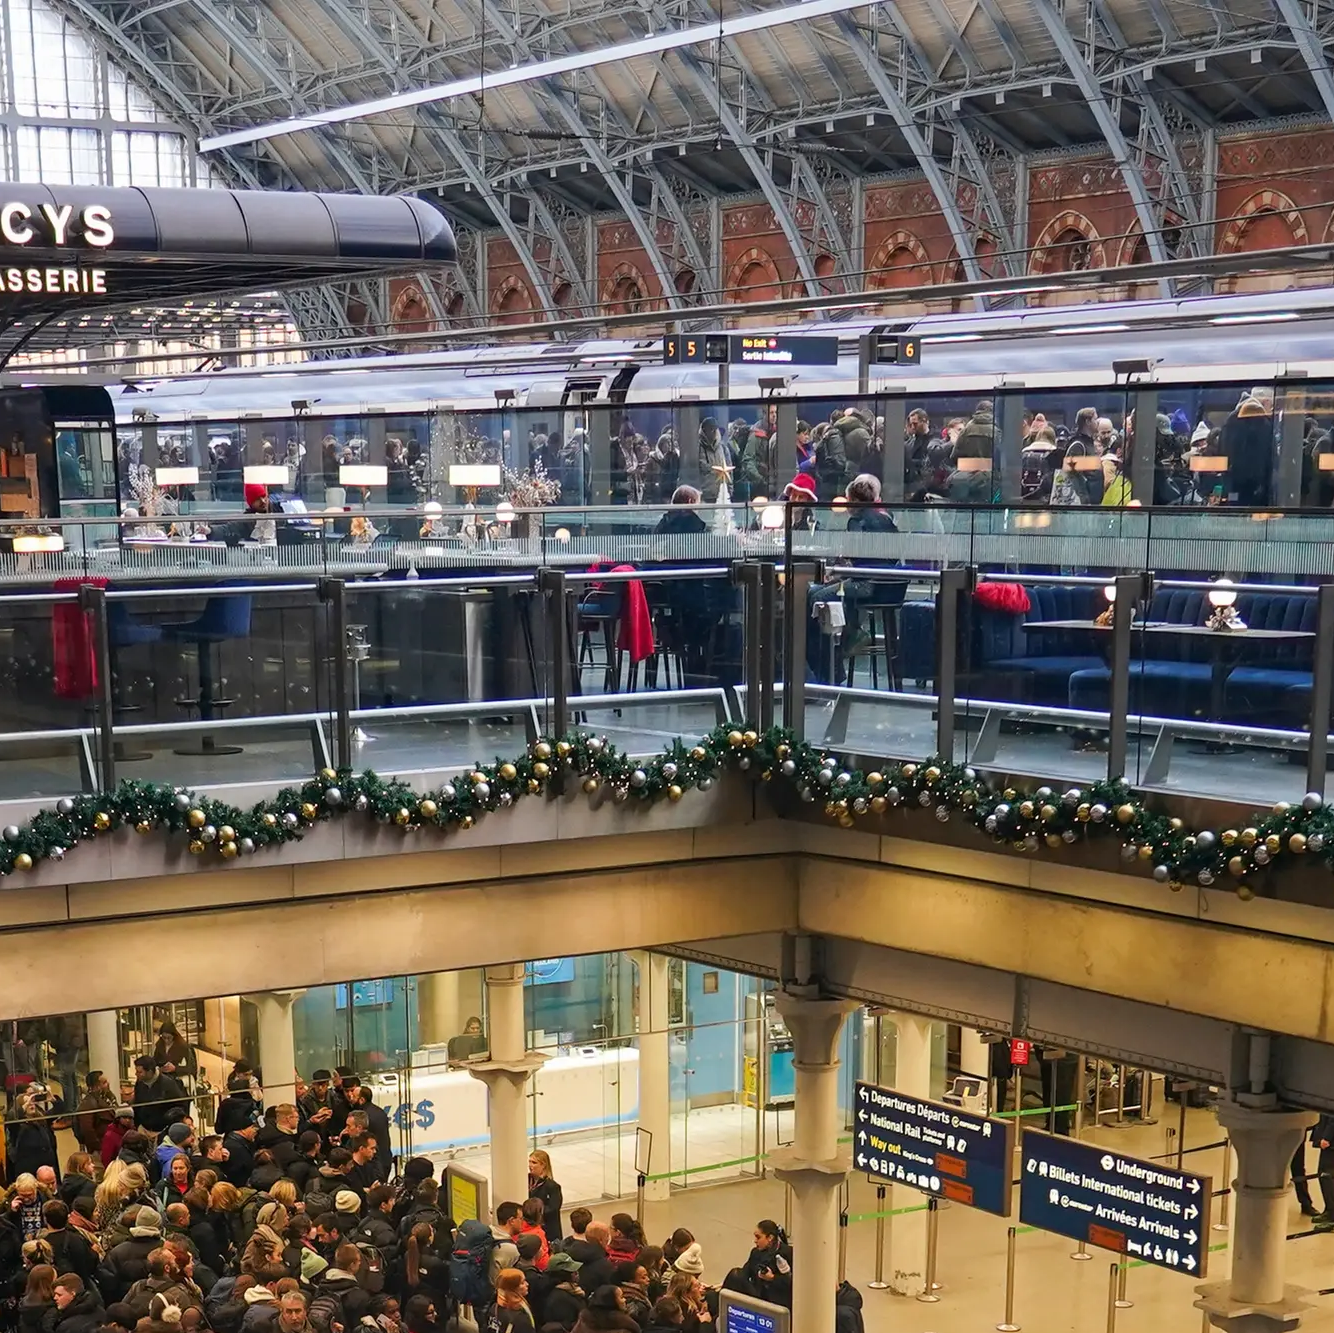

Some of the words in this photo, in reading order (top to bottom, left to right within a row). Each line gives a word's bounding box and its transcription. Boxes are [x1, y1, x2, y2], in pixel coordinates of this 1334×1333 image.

[668, 342, 675, 357] 5
[687, 341, 696, 357] 5
[742, 338, 753, 348] No
[754, 338, 767, 349] Exit
[905, 343, 914, 358] 6
[742, 350, 763, 361] Sortie
[871, 1090, 917, 1115] Departures
[917, 1104, 950, 1125] Départs
[870, 1113, 904, 1134] National
[905, 1123, 921, 1139] Rail
[870, 1134, 887, 1153] Way
[887, 1141, 902, 1156] out
[1116, 1159, 1183, 1190] Underground
[1049, 1164, 1080, 1186] Billets
[1081, 1174, 1145, 1204] International
[1146, 1193, 1181, 1214] tickets
[1095, 1204, 1138, 1227] Arrivées
[1138, 1216, 1180, 1240] Arrivals
[727, 1306, 755, 1321] Departures
